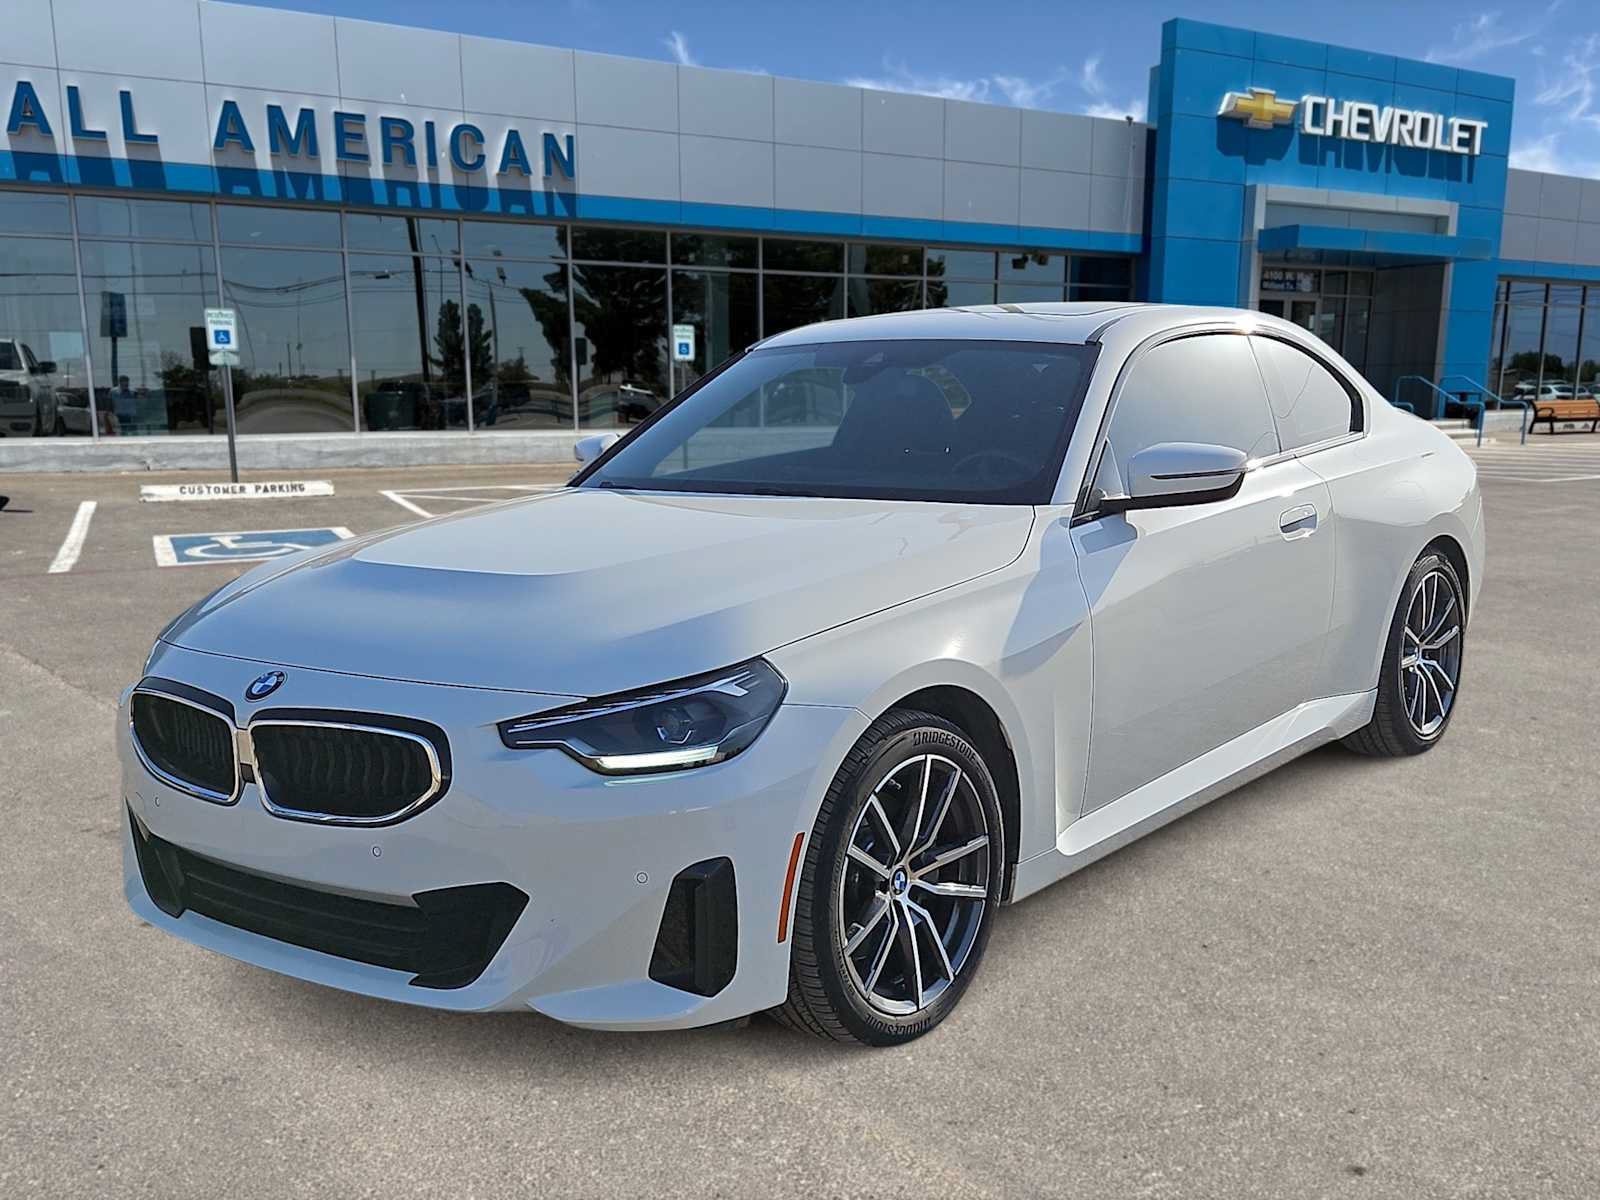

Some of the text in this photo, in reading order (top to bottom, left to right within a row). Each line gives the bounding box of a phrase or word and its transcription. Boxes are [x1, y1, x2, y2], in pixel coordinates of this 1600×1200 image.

[6, 81, 576, 179] ALL AMERICAN
[1302, 95, 1488, 155] CHEVROLET
[179, 483, 306, 495] CUSTOMER PARKING
[913, 731, 976, 761] BRIDGESTONE
